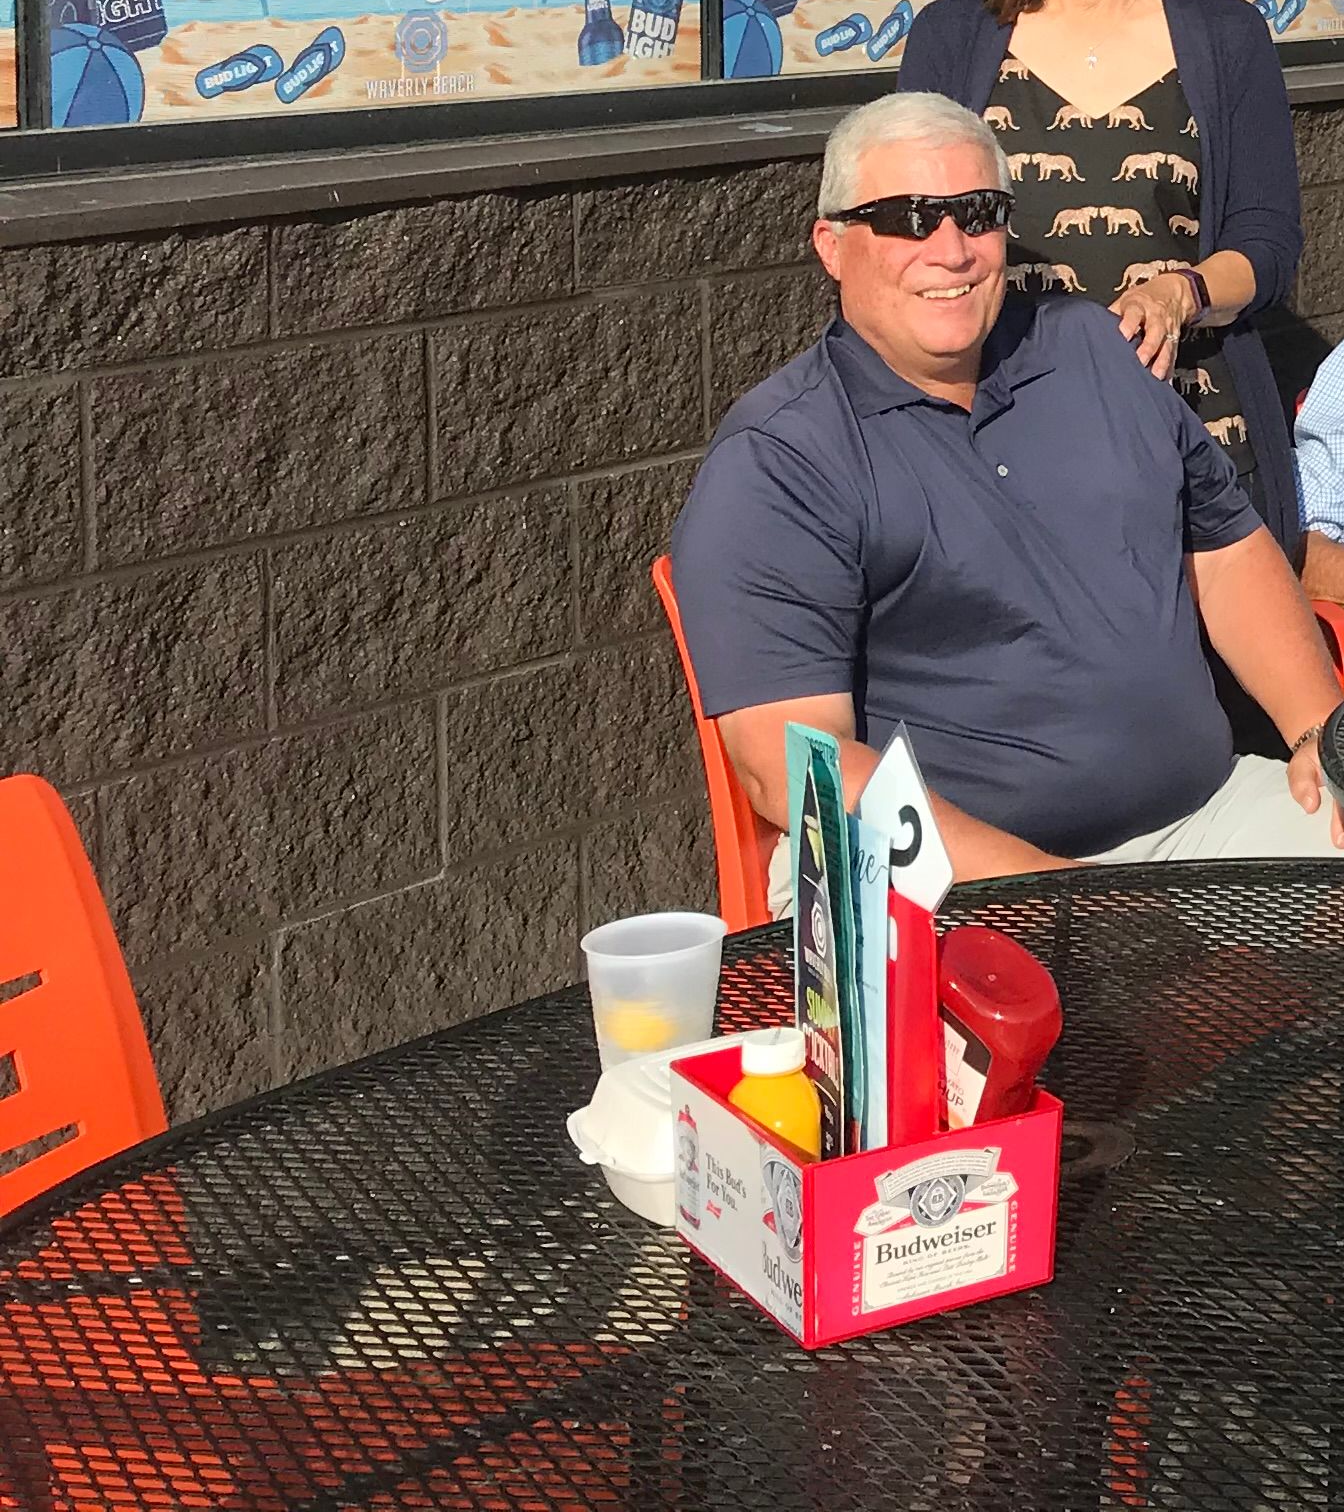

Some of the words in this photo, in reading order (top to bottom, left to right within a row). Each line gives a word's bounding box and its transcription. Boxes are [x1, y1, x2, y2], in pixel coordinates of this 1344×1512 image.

[631, 9, 676, 42] BUD
[204, 72, 233, 88] BUD
[283, 72, 308, 94] BUD
[366, 76, 428, 99] WAVERLY
[435, 73, 475, 95] BEACH
[706, 1152, 724, 1180] This
[725, 1168, 747, 1199] Bud's
[706, 1173, 719, 1196] For
[720, 1184, 738, 1211] You.
[874, 1221, 996, 1265] Budweiser
[1008, 1200, 1018, 1273] GENUINE
[852, 1241, 861, 1316] GENUINE
